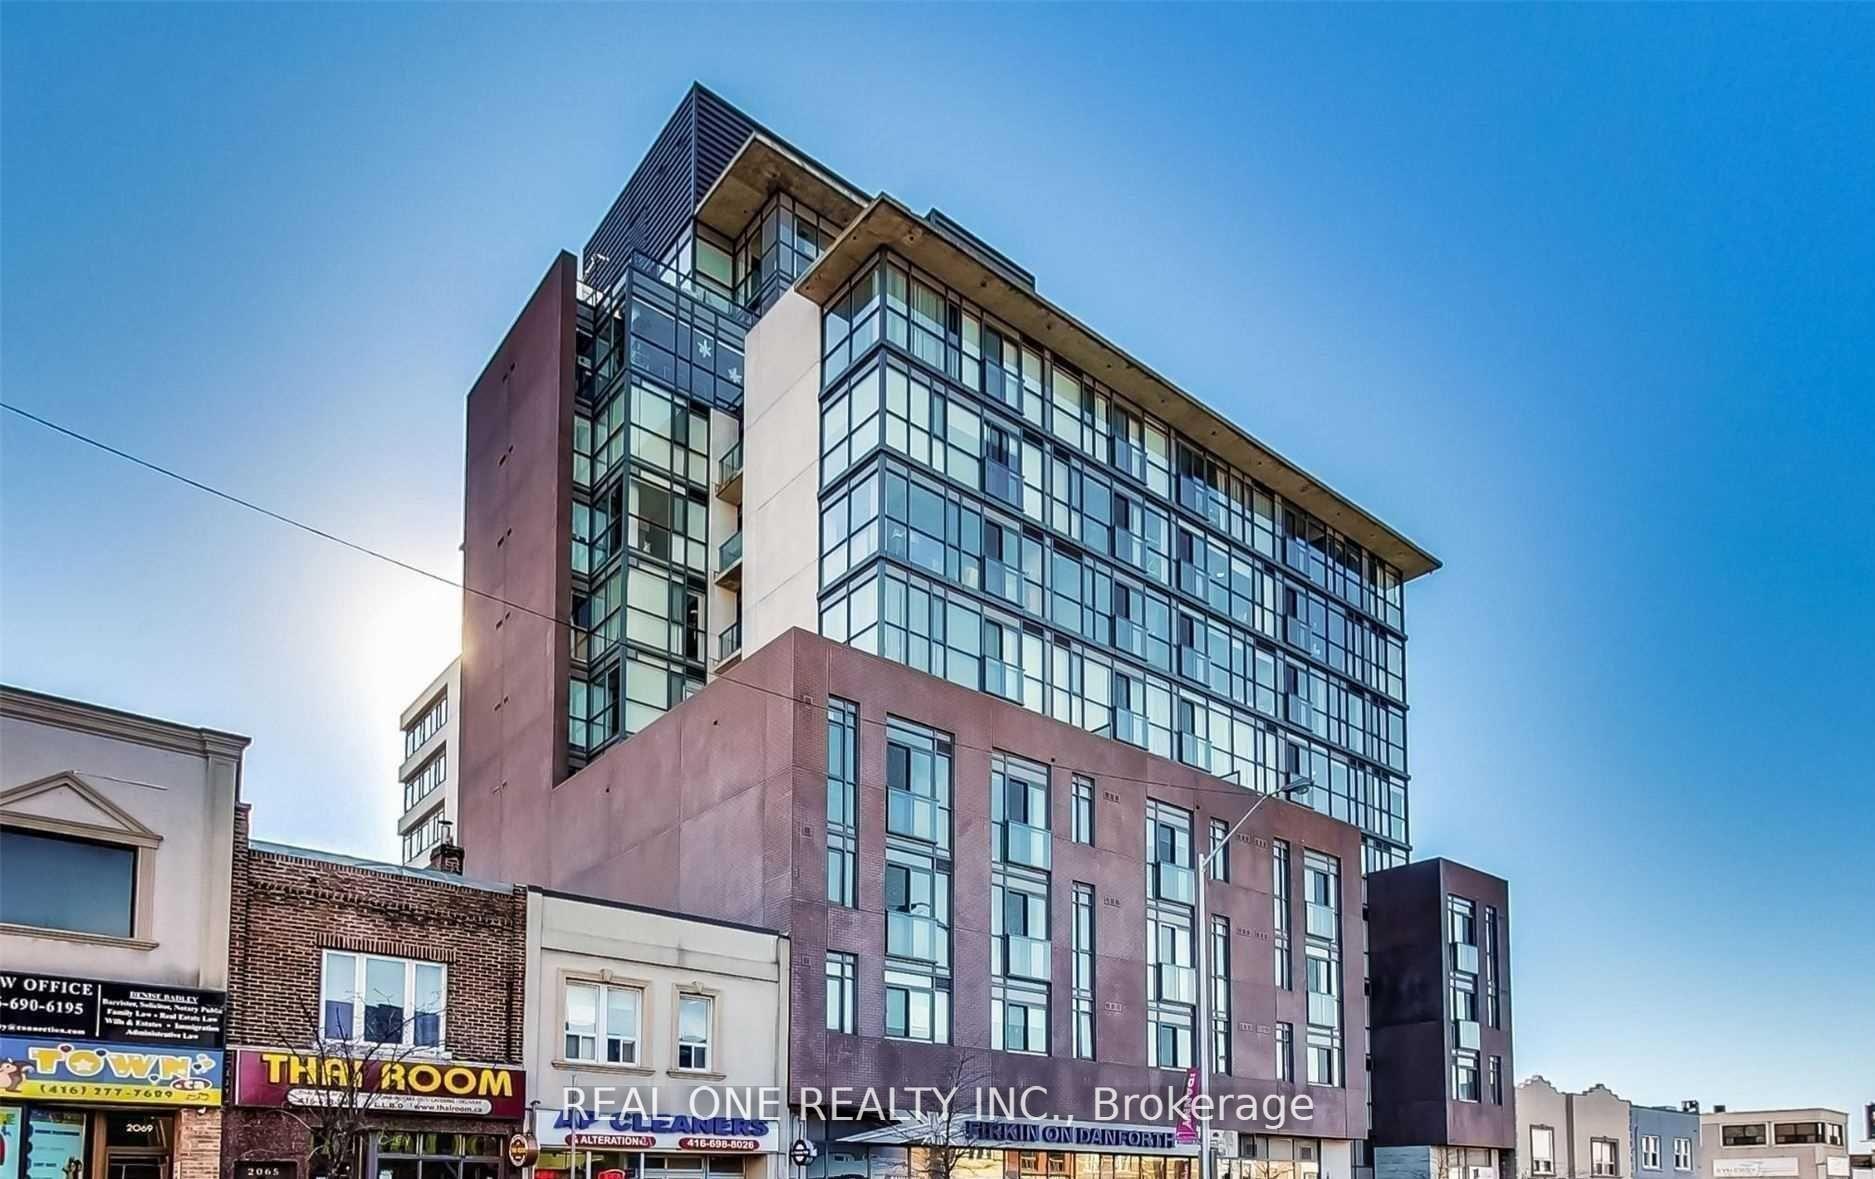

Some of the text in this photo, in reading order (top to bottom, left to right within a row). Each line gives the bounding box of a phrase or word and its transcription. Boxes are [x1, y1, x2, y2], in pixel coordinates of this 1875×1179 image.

[23, 978, 93, 996] OFFICE
[0, 996, 84, 1015] -690-6195
[174, 1004, 198, 1013] Notary
[201, 1006, 223, 1014] Public
[107, 1008, 133, 1017] Family
[160, 1012, 177, 1020] Real
[178, 1014, 200, 1022] Estate
[105, 1017, 124, 1025] Wills
[135, 1020, 162, 1028] Estates
[175, 1022, 220, 1032] Immigration
[126, 1029, 181, 1038] Administrative
[29, 1046, 192, 1080] TOWN
[262, 1053, 513, 1097] THAI ROOM
[126, 1123, 153, 1133] 2069
[609, 1111, 769, 1137] CLEANERS
[965, 1121, 1176, 1149] FIRKIN ON DANFORTH
[247, 1167, 280, 1176] 2065
